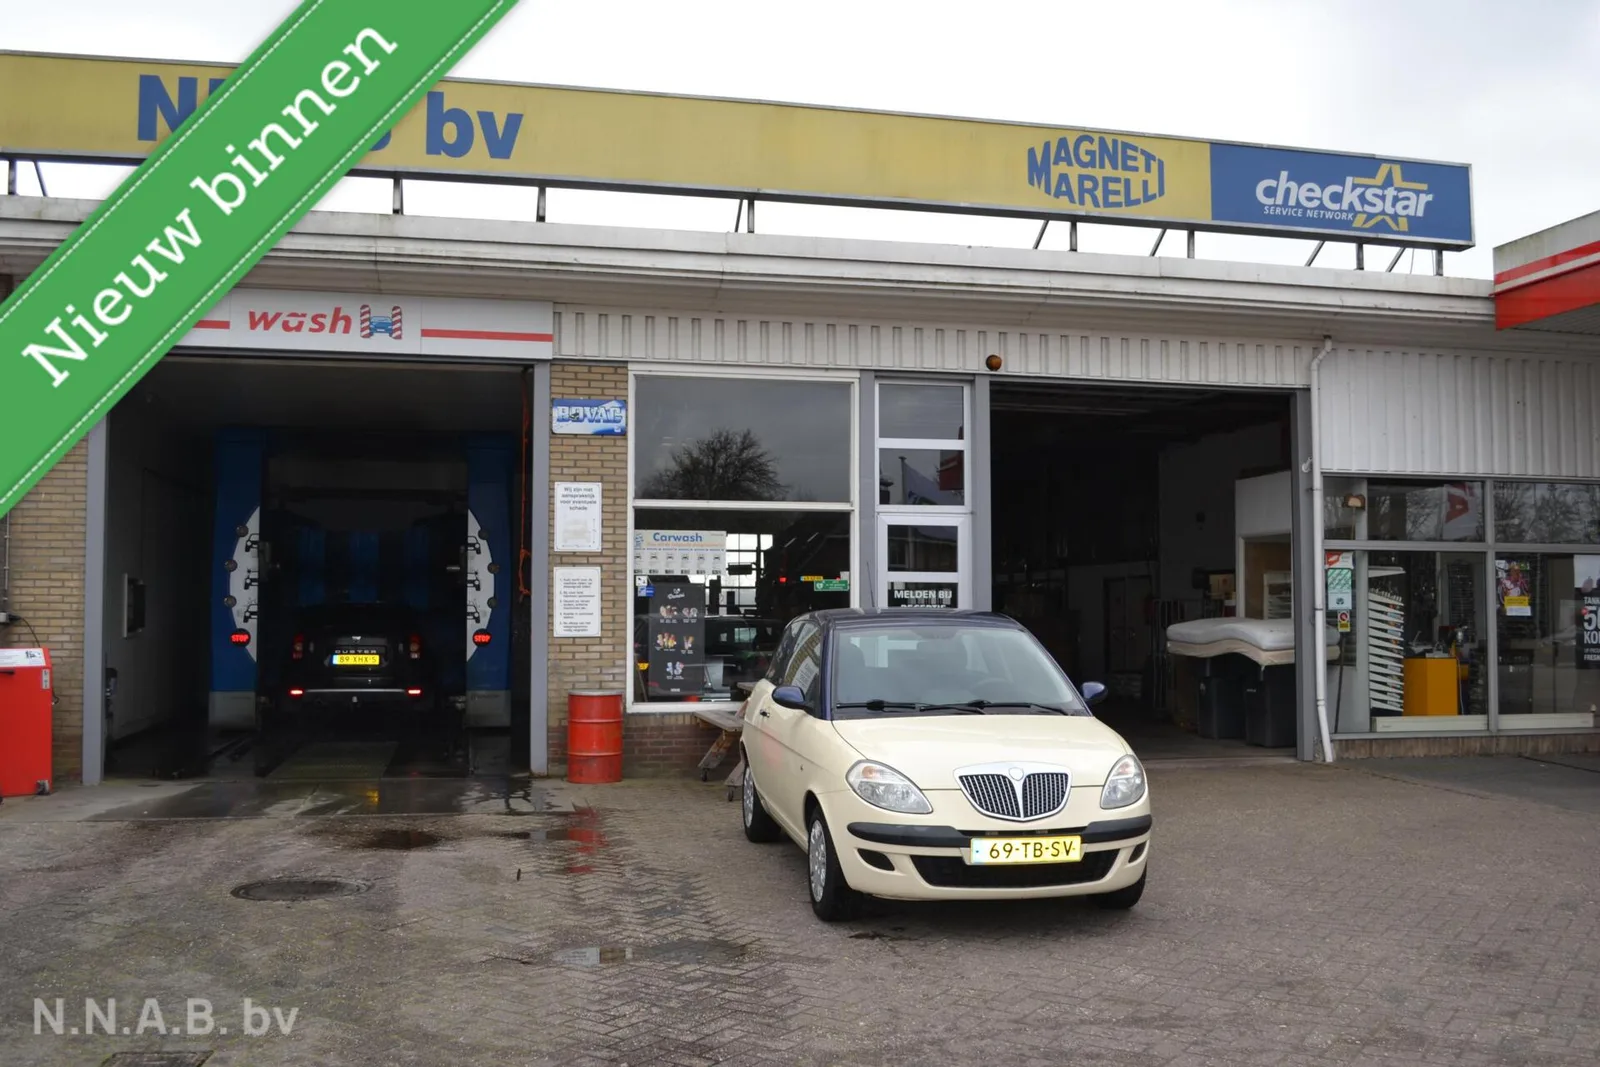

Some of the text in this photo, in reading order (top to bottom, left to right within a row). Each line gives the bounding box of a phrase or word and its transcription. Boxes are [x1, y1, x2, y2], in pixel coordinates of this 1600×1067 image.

[426, 91, 524, 159] bv
[1028, 135, 1164, 184] MAGNETI
[1028, 158, 1164, 208] MARELLI
[1255, 170, 1433, 217] checkstar
[1263, 205, 1353, 221] SERVICE NETWORK
[248, 306, 353, 335] wash
[653, 532, 703, 542] Carwash
[894, 590, 952, 599] MELDEN BIJ
[231, 634, 249, 642] STOP
[473, 634, 491, 642] STOP
[1584, 631, 1600, 645] KO
[989, 841, 1074, 859] 69-TB-SV
